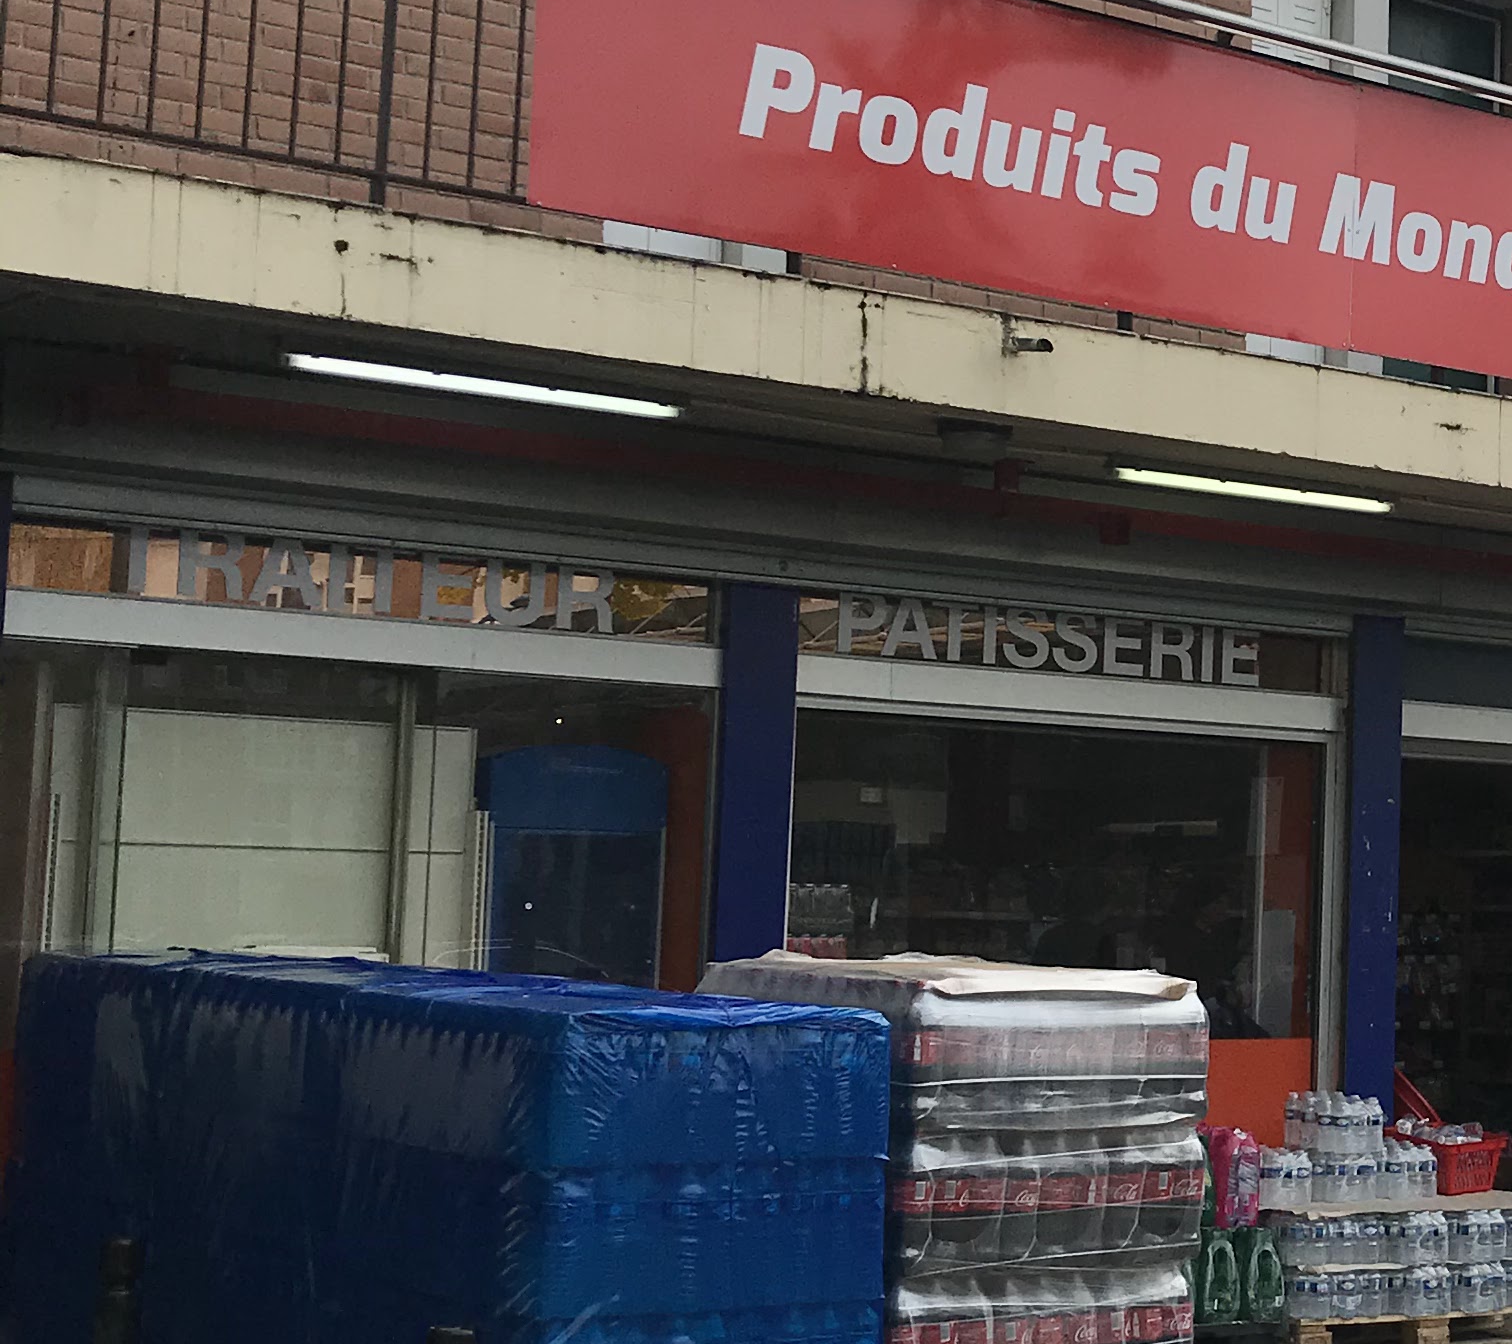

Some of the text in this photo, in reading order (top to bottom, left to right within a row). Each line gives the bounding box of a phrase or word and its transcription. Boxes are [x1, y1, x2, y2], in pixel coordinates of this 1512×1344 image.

[738, 42, 1163, 219] Produits
[1190, 141, 1299, 244] du
[837, 591, 1260, 687] PATISSERIE
